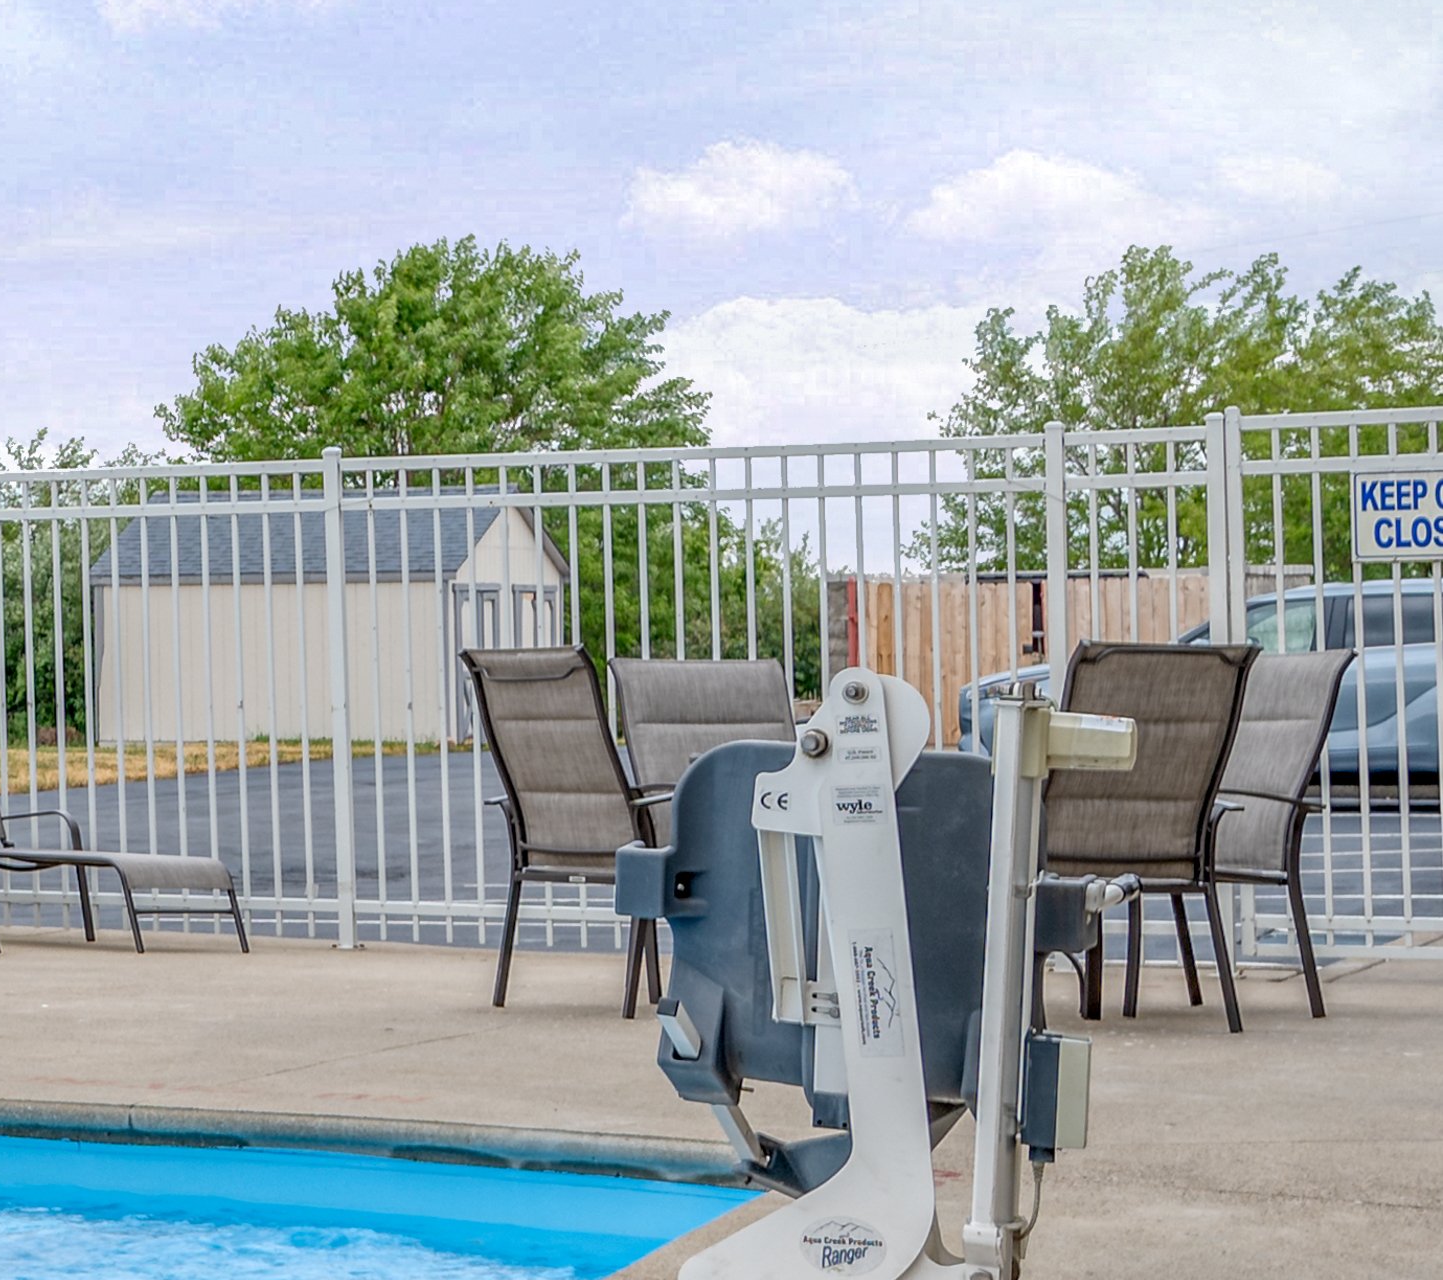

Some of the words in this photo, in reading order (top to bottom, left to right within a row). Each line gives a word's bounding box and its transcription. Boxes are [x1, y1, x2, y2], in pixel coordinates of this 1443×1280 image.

[1361, 479, 1428, 511] KEEP
[760, 791, 788, 811] CE
[864, 946, 873, 968] Aqua
[867, 970, 876, 997] Creek
[870, 999, 880, 1039] Products
[803, 1235, 822, 1244] Aqua
[824, 1236, 847, 1245] Creek
[848, 1236, 883, 1247] Products
[822, 1245, 869, 1269] Ranger
